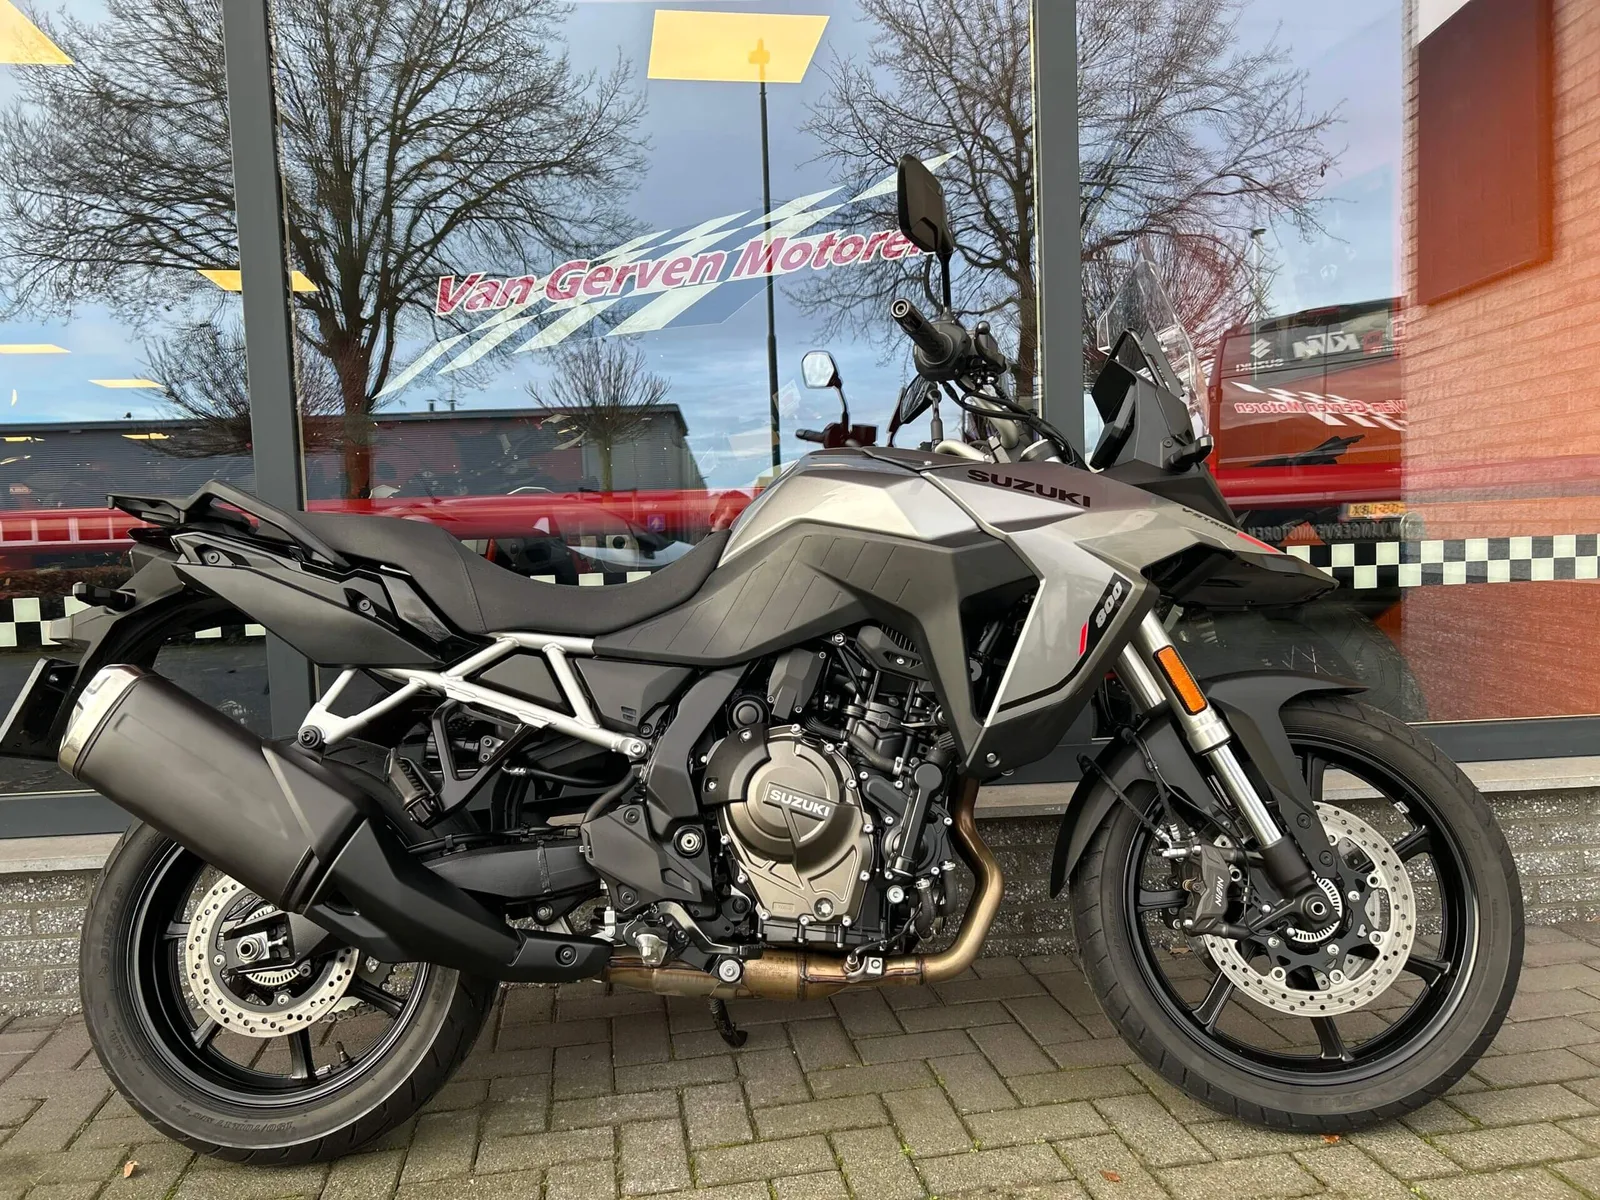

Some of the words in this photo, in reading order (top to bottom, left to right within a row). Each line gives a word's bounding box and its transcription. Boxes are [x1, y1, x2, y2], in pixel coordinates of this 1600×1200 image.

[435, 271, 536, 315] Van
[545, 251, 727, 303] Gerven
[967, 469, 1091, 508] SUZUKI
[1095, 581, 1123, 629] 800
[769, 789, 831, 817] SUZUKI
